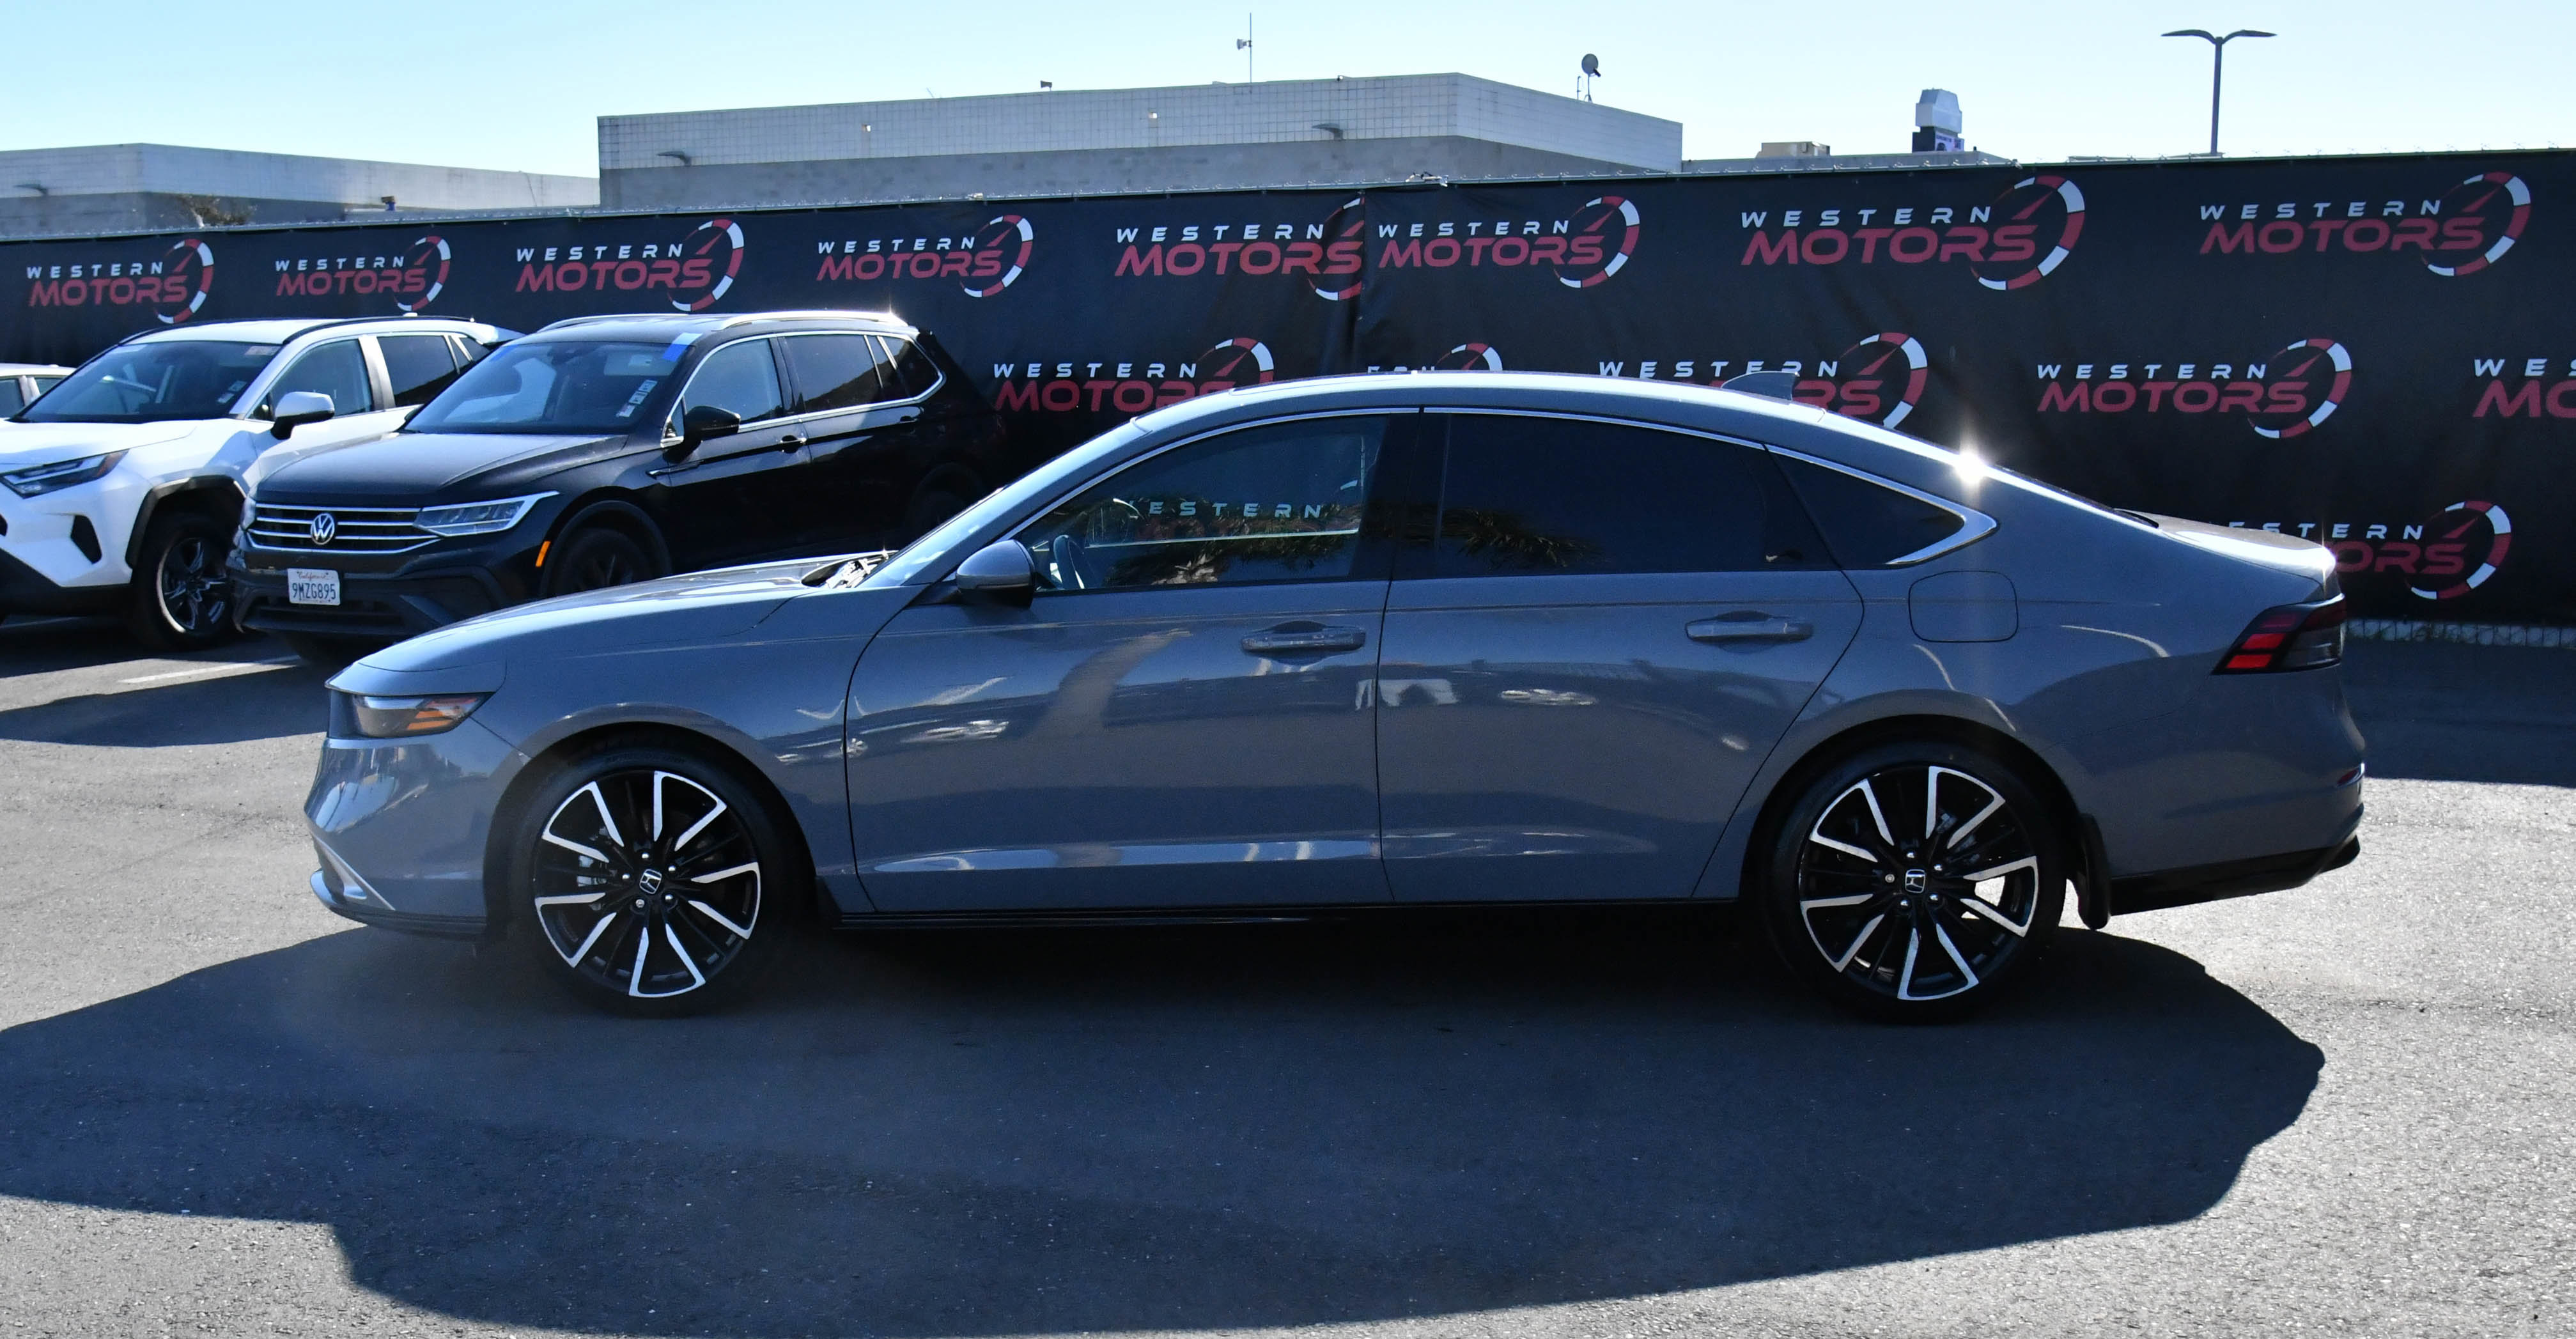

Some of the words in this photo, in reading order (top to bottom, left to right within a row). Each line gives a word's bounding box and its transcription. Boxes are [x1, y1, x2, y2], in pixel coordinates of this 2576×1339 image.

[1741, 206, 1991, 228] WESTERN
[2200, 200, 2440, 220] WESTERN
[1116, 224, 1324, 243] WESTERN
[1378, 220, 1569, 238] WESTERN
[2200, 217, 2485, 254] MOTORS
[516, 243, 683, 262] WESTERN
[818, 236, 975, 254] WESTERN
[1378, 235, 1605, 268] MOTORS
[1741, 224, 2038, 266] MOTORS
[275, 256, 405, 272] WESTERN
[816, 250, 1002, 281] MOTORS
[1114, 241, 1363, 277] MOTORS
[26, 261, 164, 279] WESTERN
[515, 258, 713, 292] MOTORS
[29, 275, 188, 307] MOTORS
[275, 268, 426, 297] MOTORS
[993, 363, 1197, 378] WESTERN
[2037, 364, 2267, 379] WESTERN
[2037, 380, 2309, 414] MOTORS
[1129, 500, 1321, 518] ESTERN
[2228, 521, 2424, 540] STERN
[292, 582, 336, 601] 9MZG895
